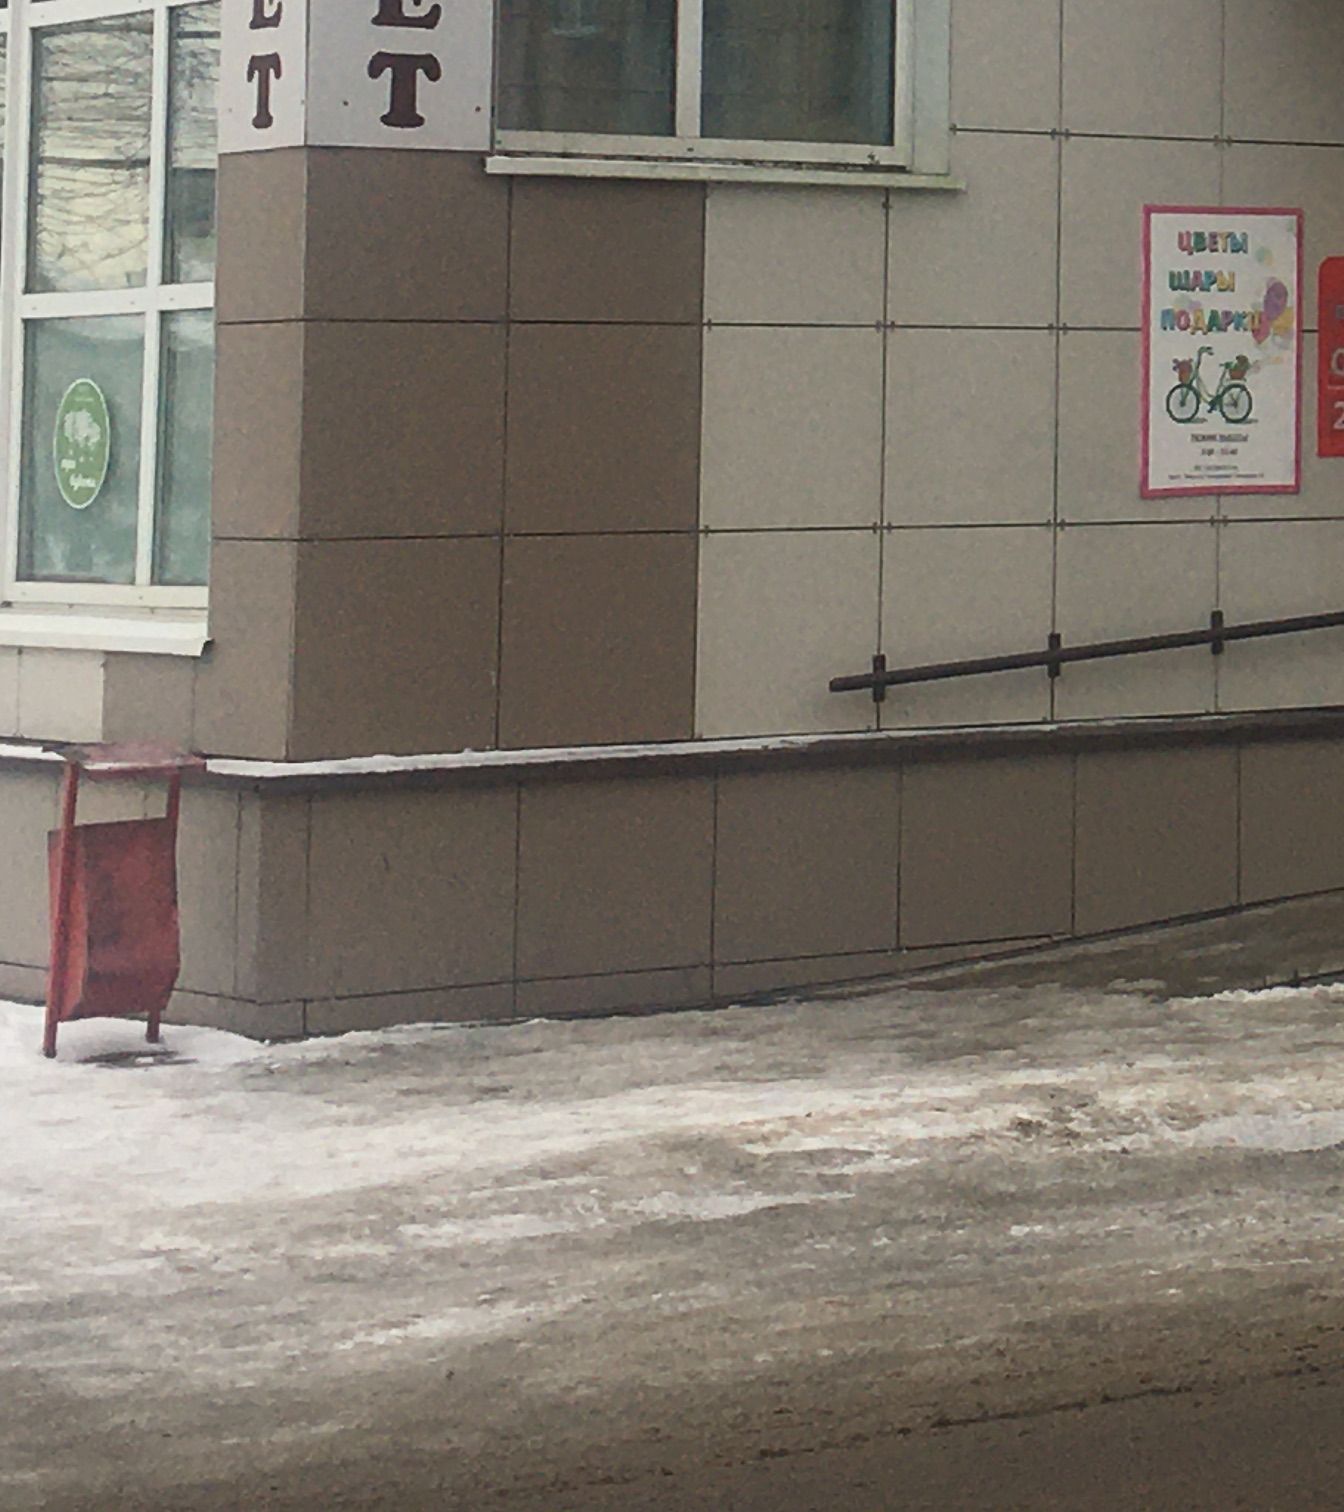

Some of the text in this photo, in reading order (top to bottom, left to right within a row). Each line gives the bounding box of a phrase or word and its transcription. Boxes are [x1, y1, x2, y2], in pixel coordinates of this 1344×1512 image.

[1177, 231, 1249, 255] ЦВЕТЫ
[1168, 270, 1236, 293] ШАРЫ
[1160, 308, 1263, 335] ПОДАРКИ
